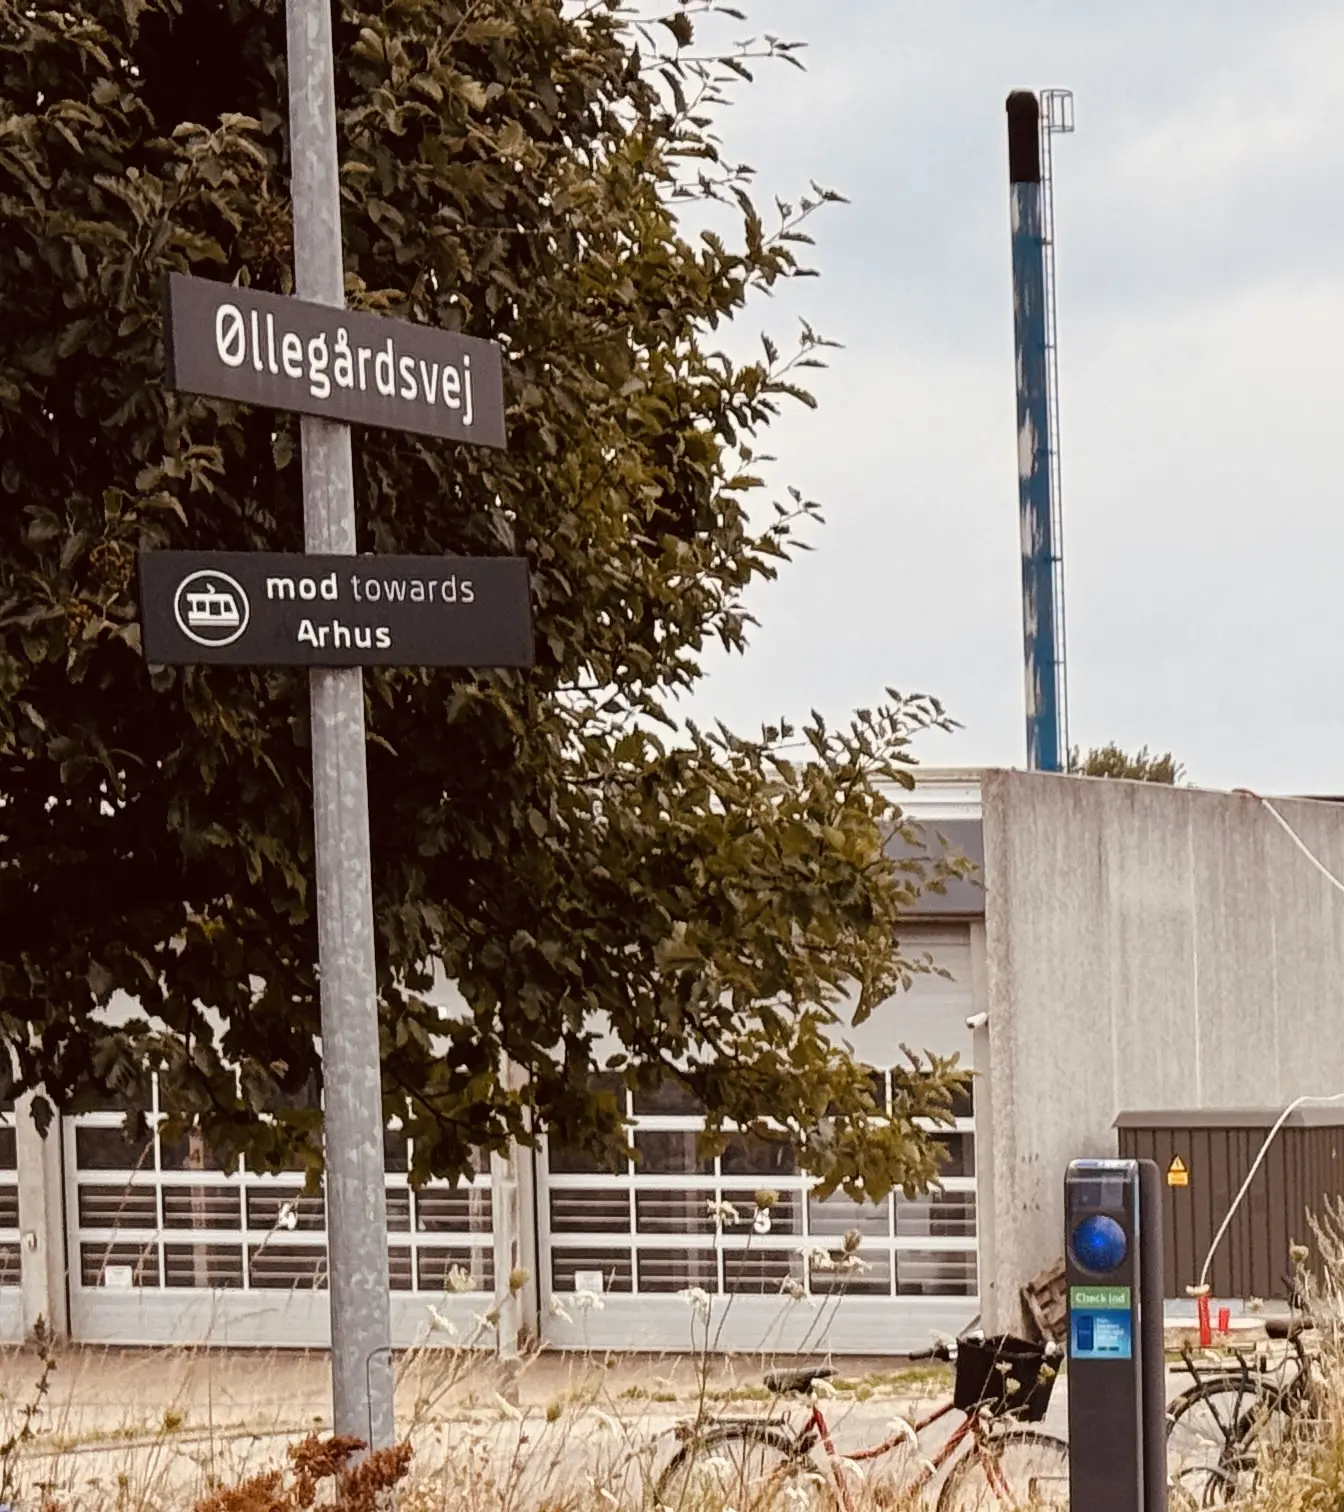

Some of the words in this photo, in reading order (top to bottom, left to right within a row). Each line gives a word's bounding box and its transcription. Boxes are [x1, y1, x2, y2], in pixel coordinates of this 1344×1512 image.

[215, 303, 474, 426] Øllegårdsvej
[265, 572, 339, 600] mod
[350, 574, 475, 603] towards
[297, 618, 392, 648] Arhus
